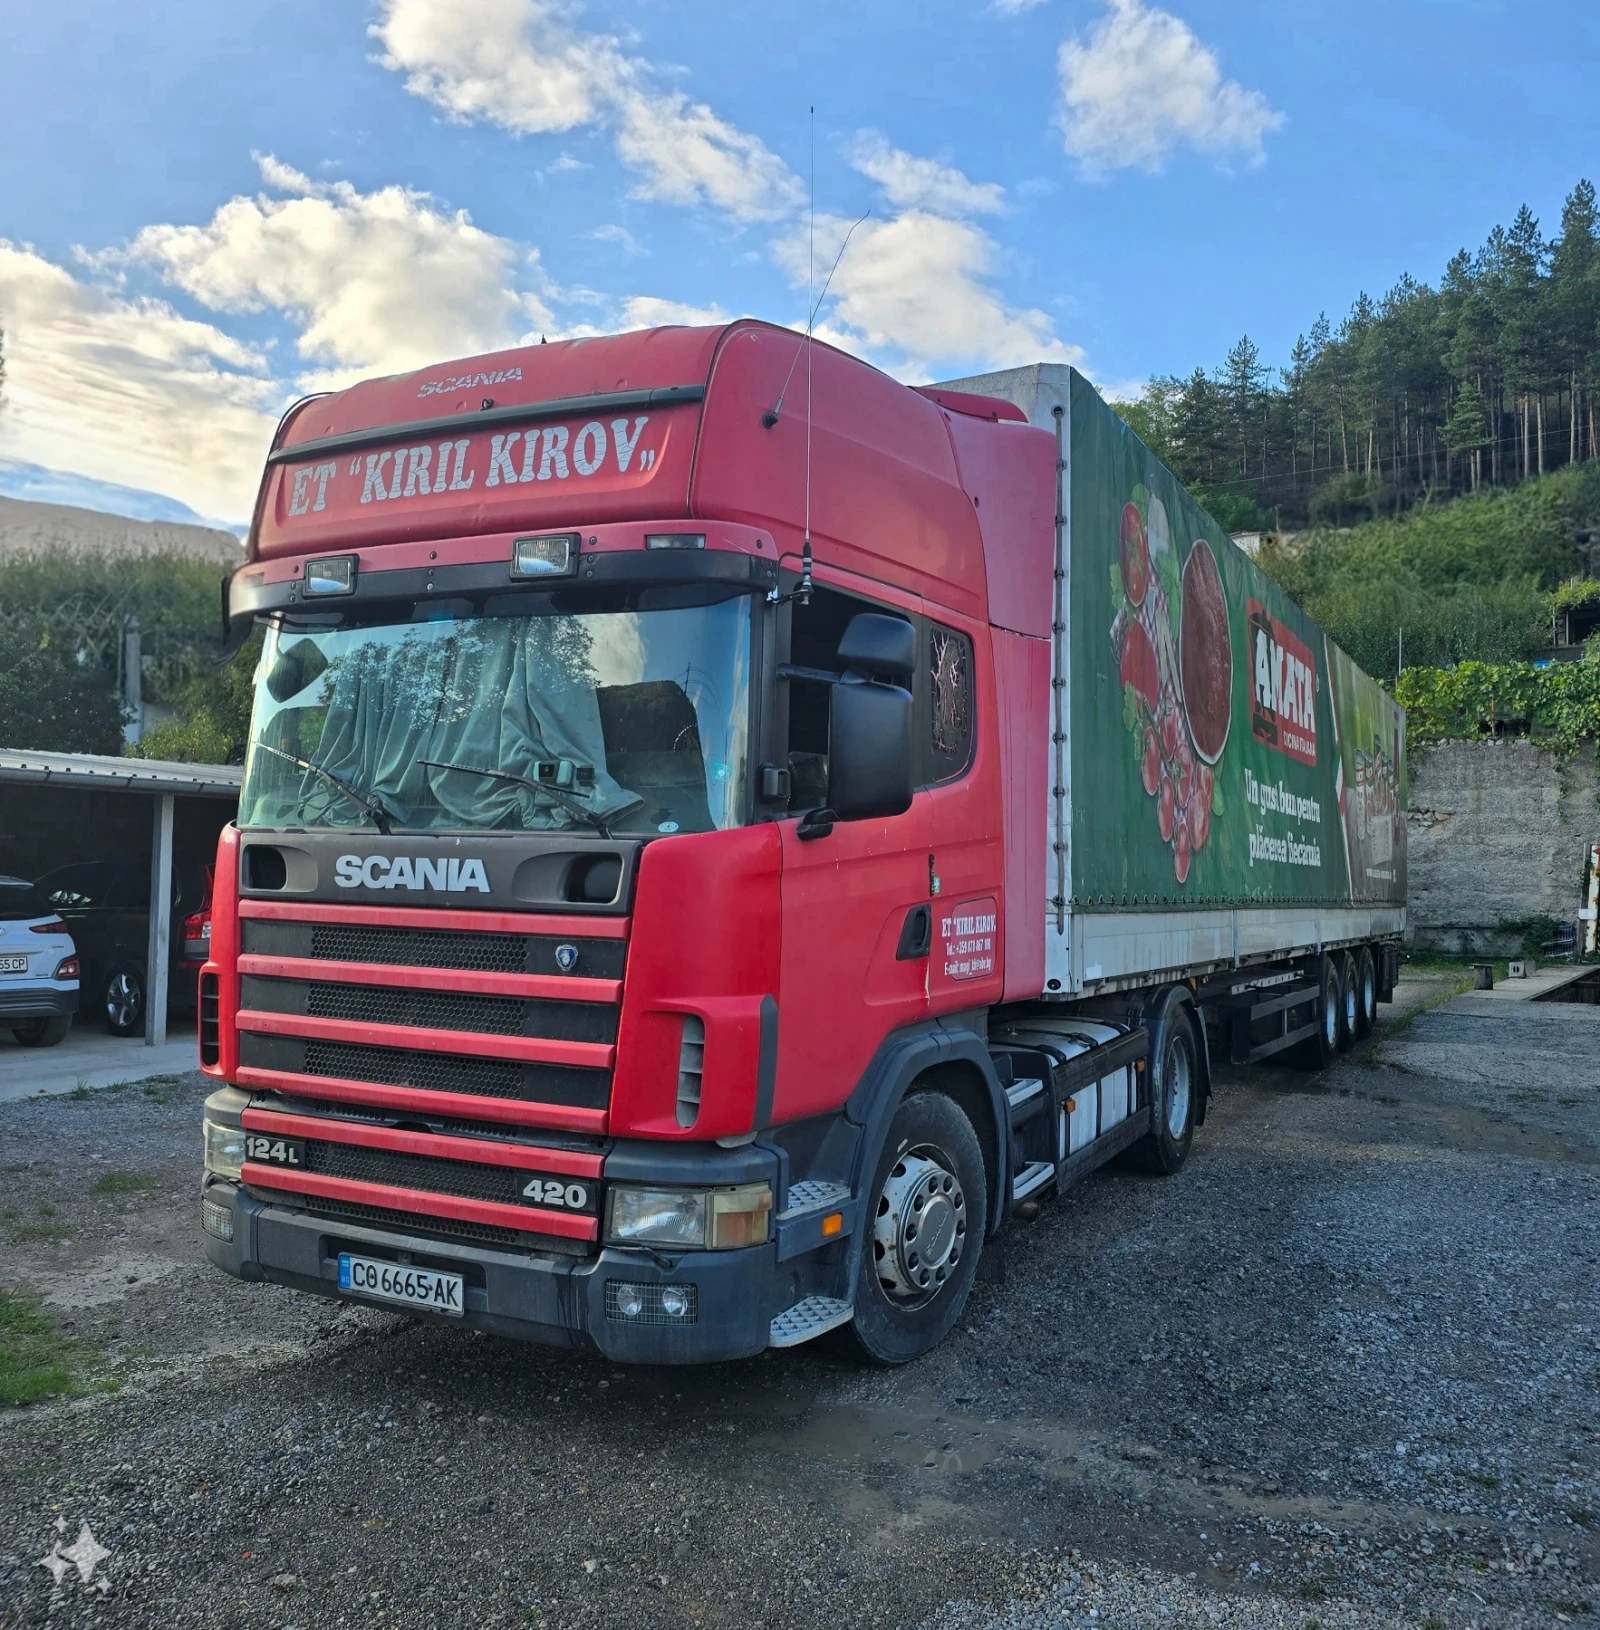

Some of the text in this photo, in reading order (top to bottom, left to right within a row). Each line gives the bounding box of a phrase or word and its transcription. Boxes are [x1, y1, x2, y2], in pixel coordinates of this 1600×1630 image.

[417, 367, 522, 398] SCANIA
[288, 462, 337, 517] ET
[1255, 628, 1316, 734] AMATA
[1244, 768, 1258, 805] Un
[1260, 783, 1279, 816] gust
[1279, 780, 1297, 817] bun
[1297, 796, 1320, 826] pentru
[1249, 823, 1287, 867] plăcerea
[334, 854, 490, 893] SCANIA
[941, 917, 951, 937] ET
[12, 958, 25, 970] CP
[523, 1179, 587, 1209] 420
[381, 1268, 430, 1300] 6665
[433, 1277, 459, 1307] AK
